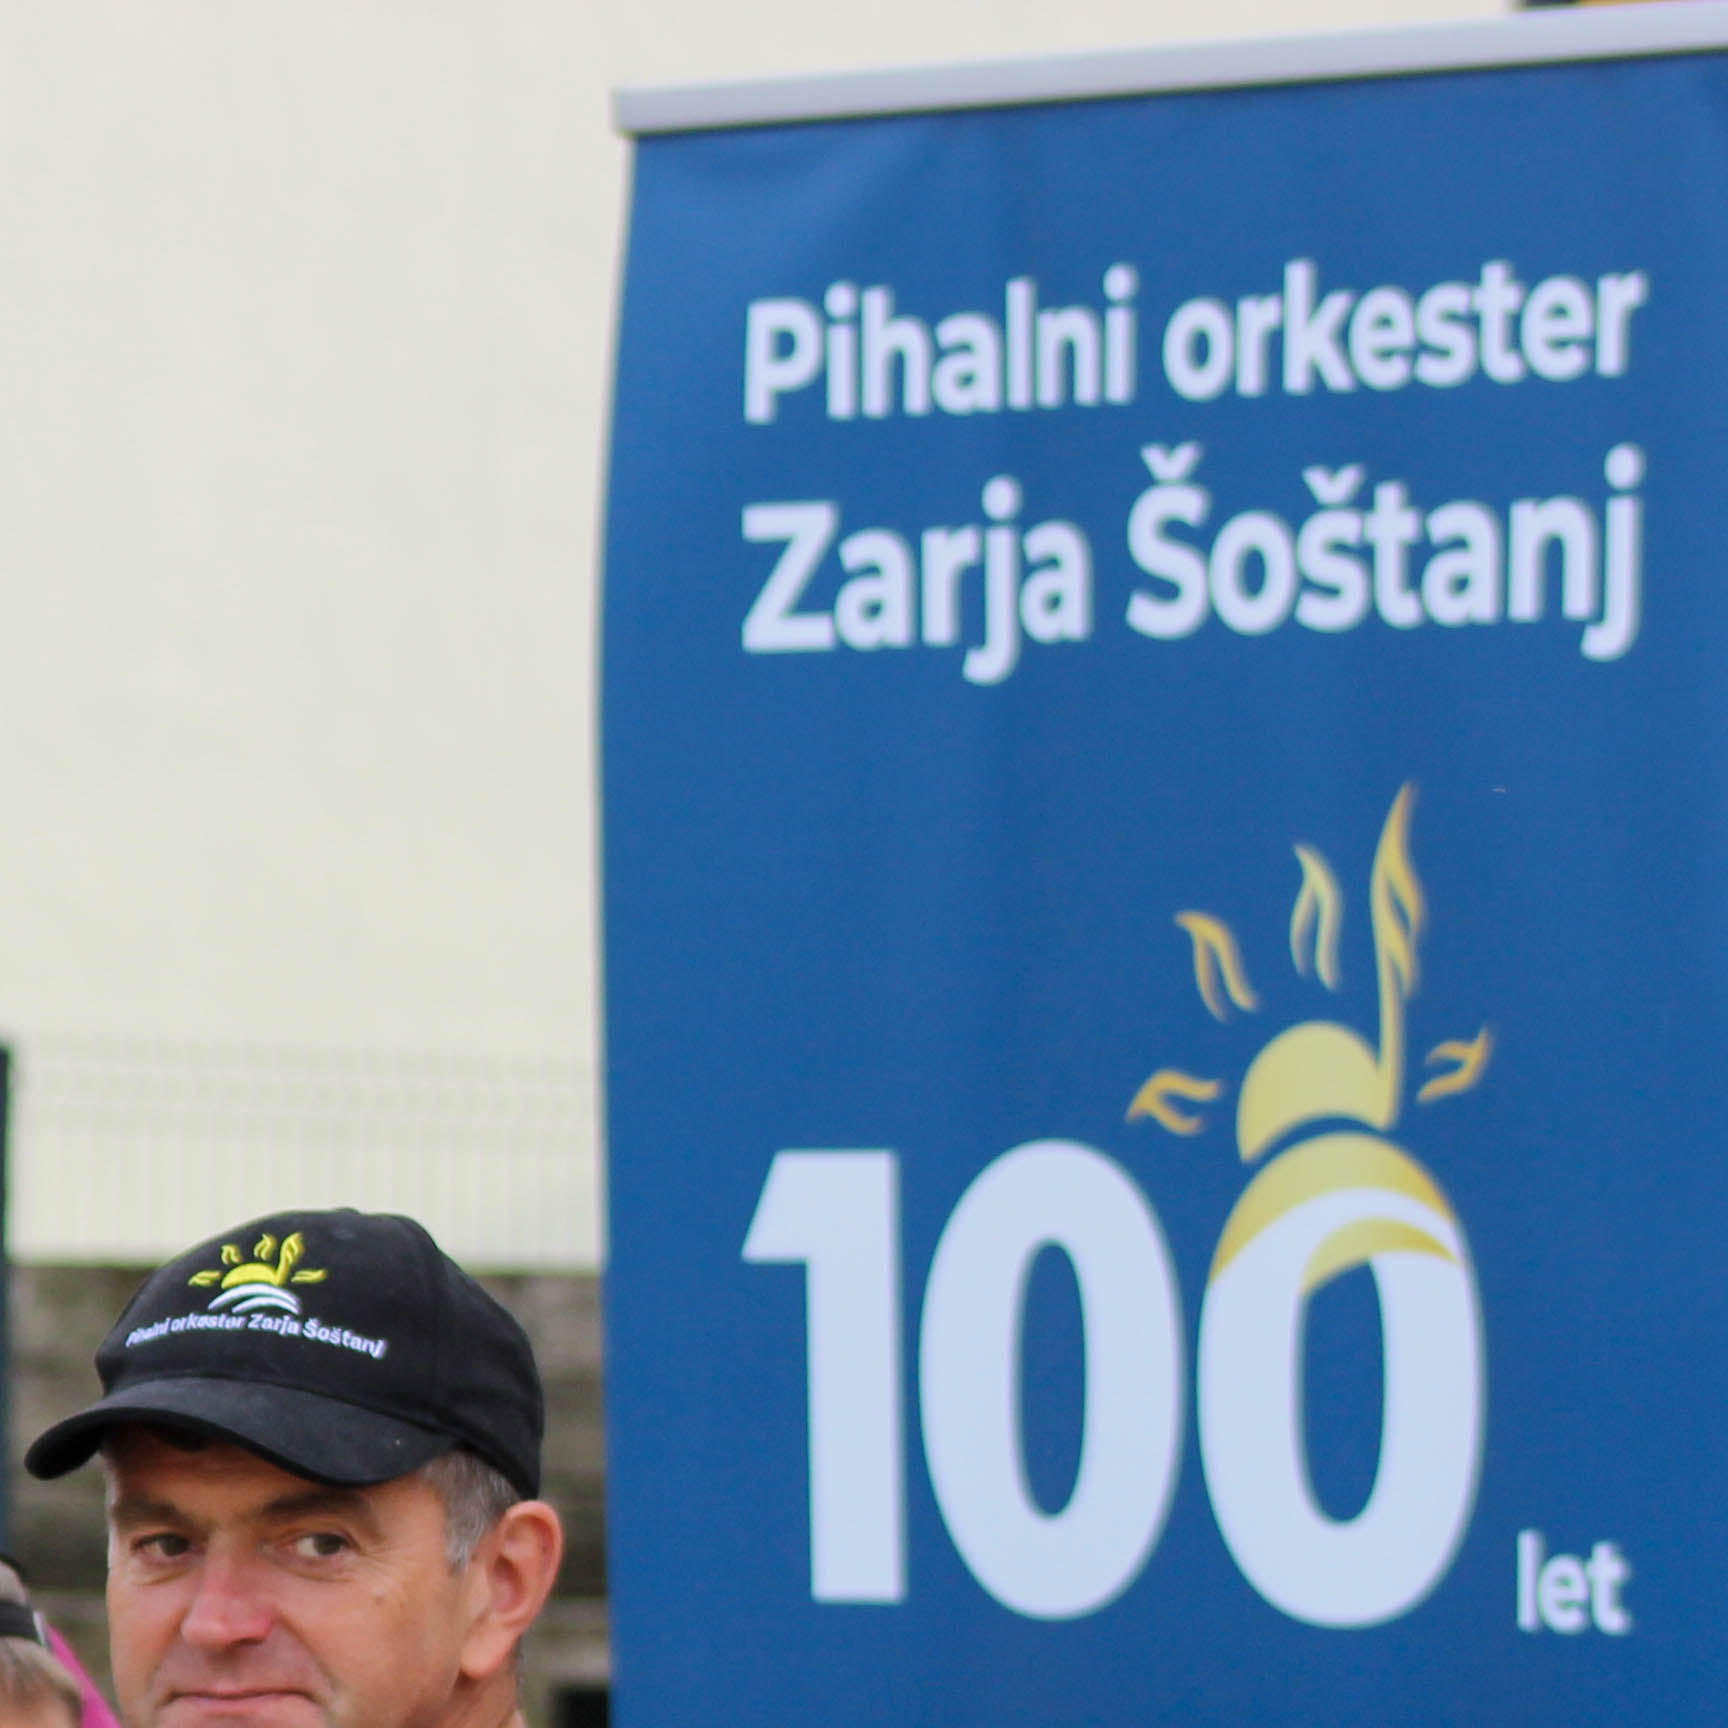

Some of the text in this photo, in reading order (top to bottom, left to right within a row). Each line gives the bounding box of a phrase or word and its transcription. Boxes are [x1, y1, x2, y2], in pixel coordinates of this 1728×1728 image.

[744, 257, 1649, 423] Pihalni orkester
[741, 441, 1646, 685] Zarja Šoštanj
[742, 1137, 1632, 1636] 100 let
